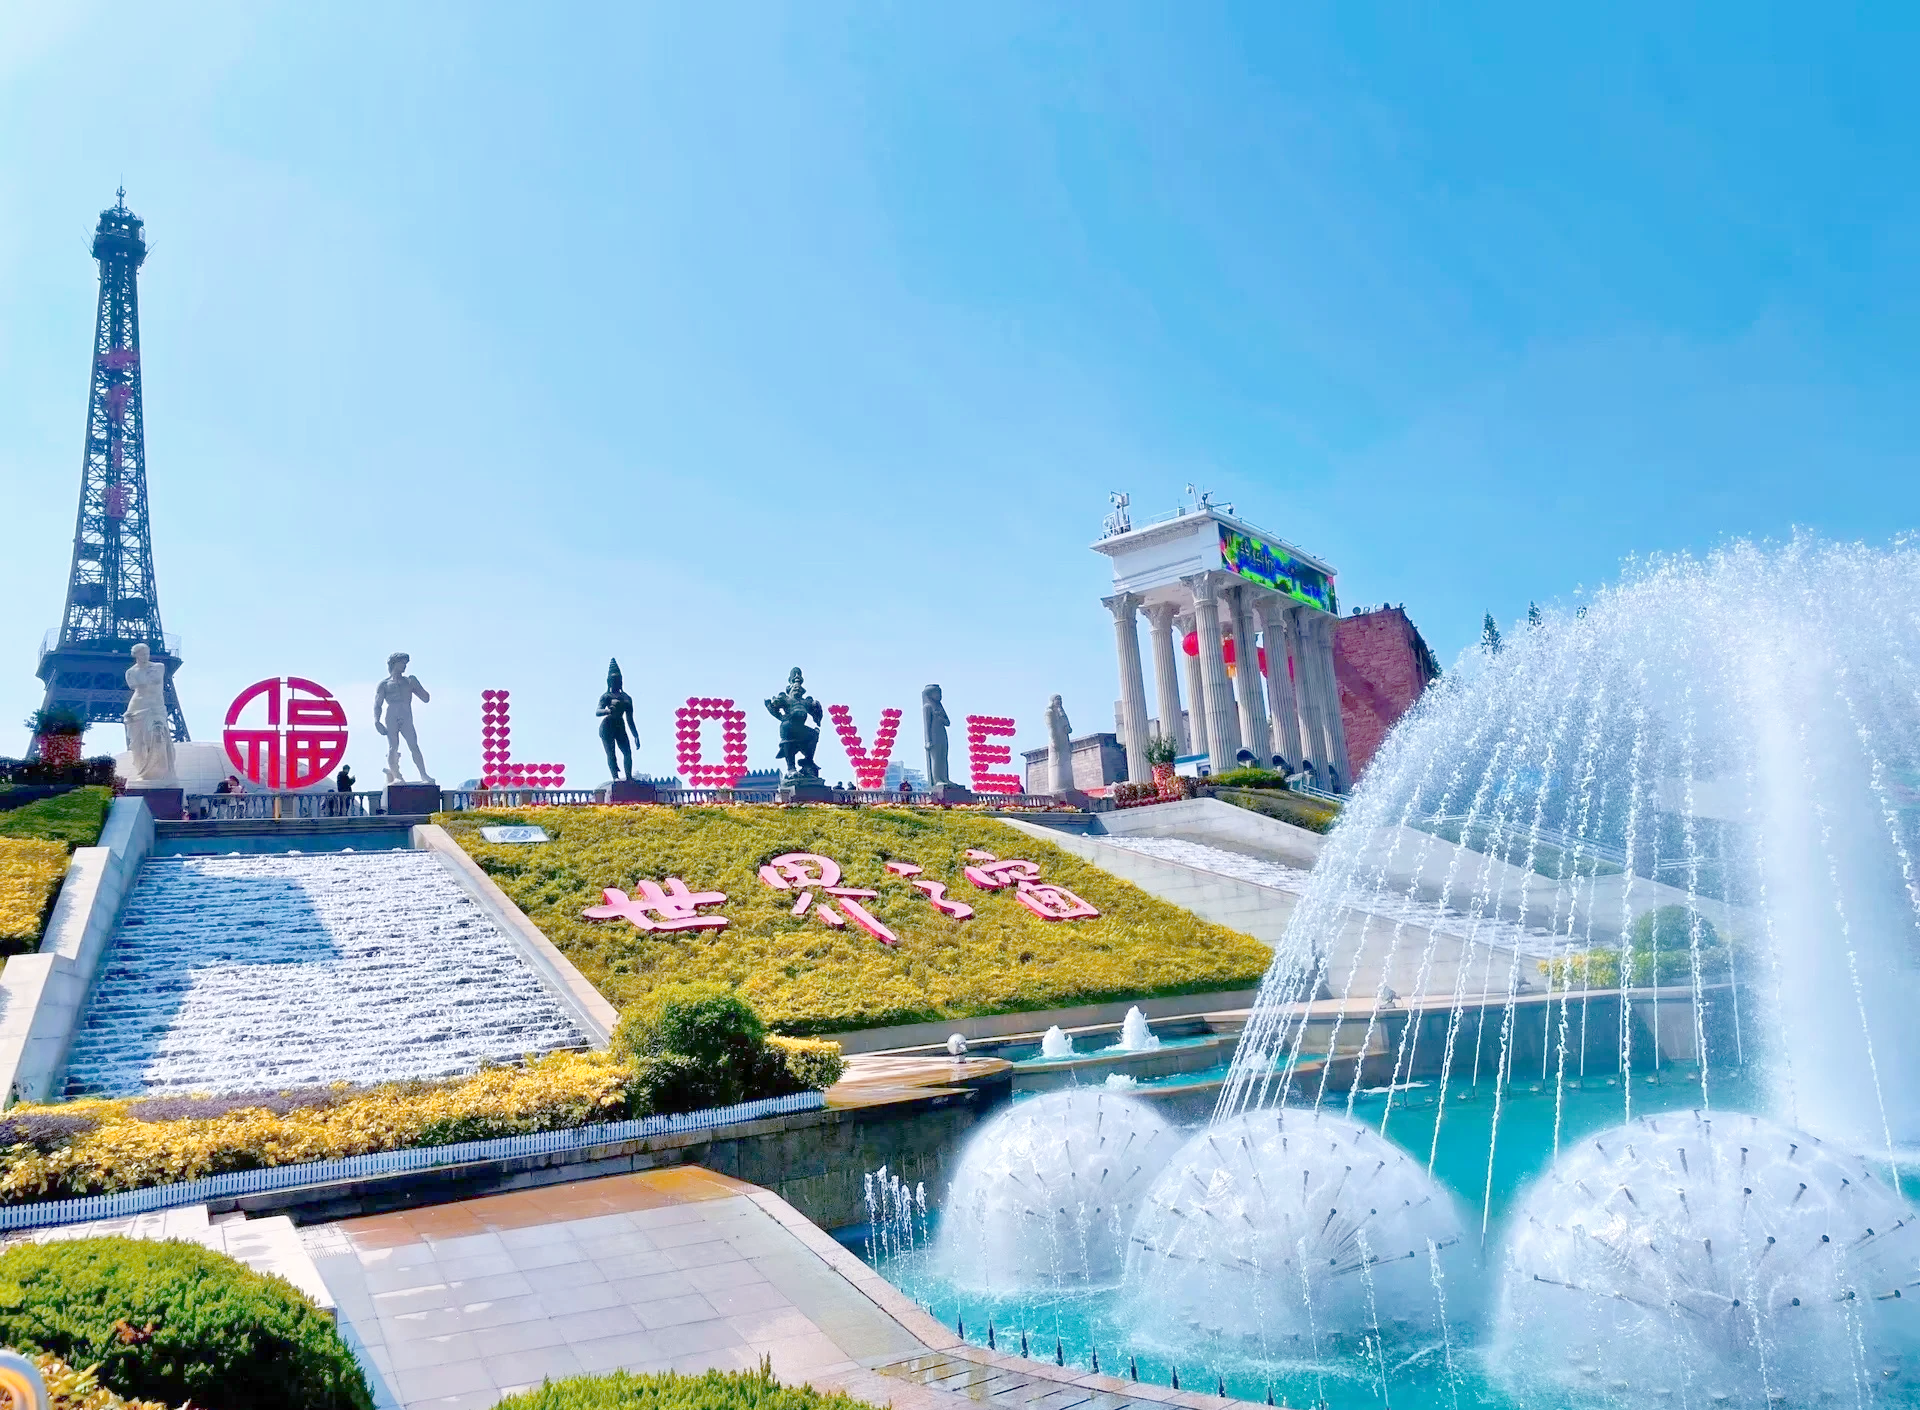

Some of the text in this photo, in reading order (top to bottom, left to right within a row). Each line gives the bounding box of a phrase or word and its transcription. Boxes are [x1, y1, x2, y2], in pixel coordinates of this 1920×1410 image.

[223, 677, 348, 789] 福
[482, 689, 1021, 794] LOVE
[582, 849, 1100, 945] 世界之窗
